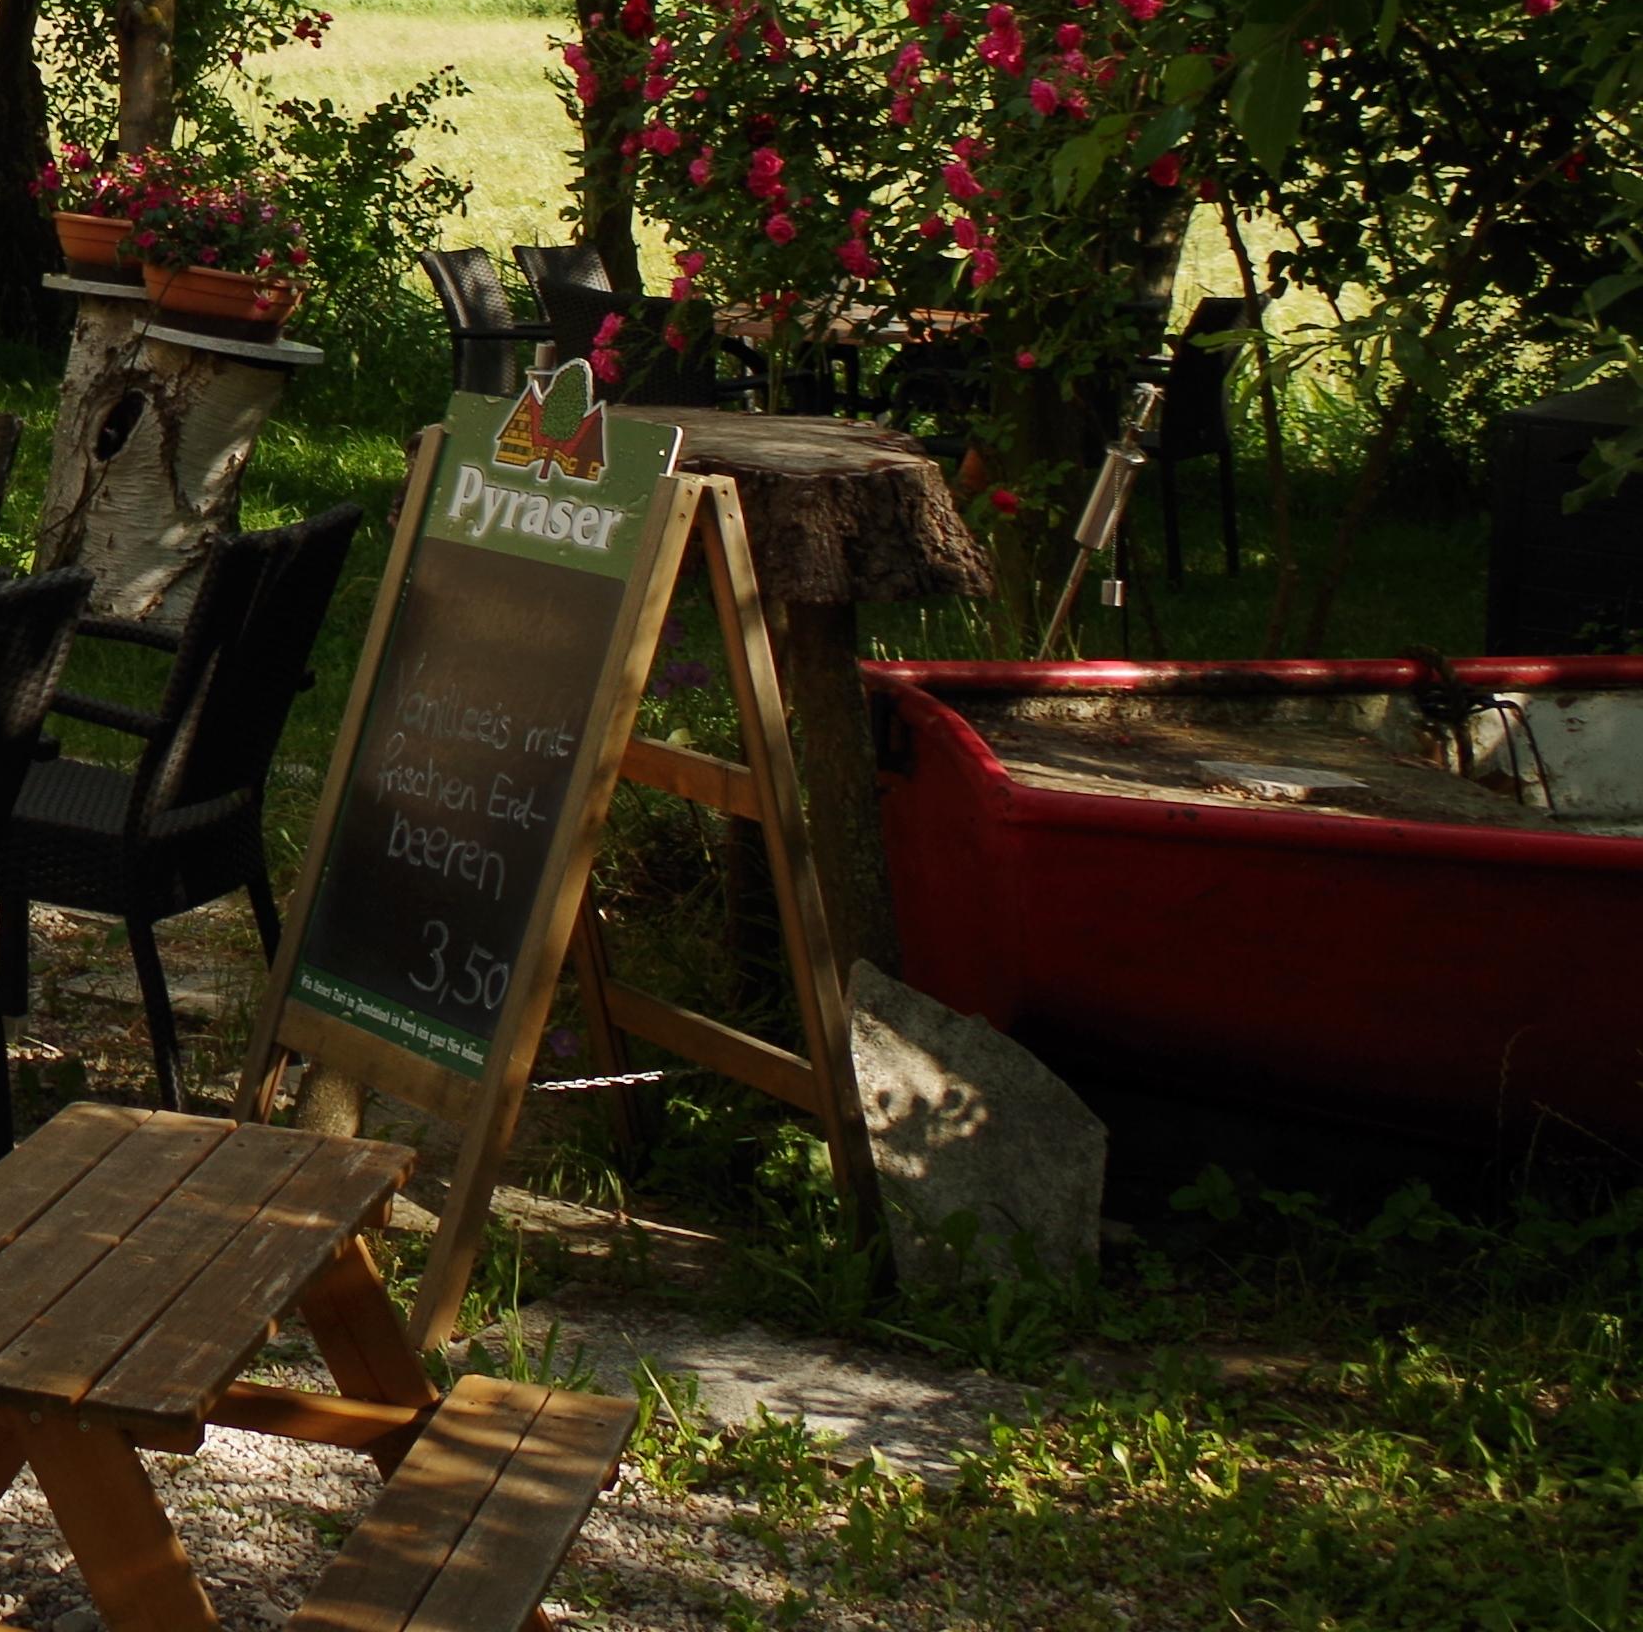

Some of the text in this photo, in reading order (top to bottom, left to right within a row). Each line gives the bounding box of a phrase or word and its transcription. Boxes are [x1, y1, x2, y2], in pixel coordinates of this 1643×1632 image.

[447, 464, 625, 552] Pyraser
[376, 731, 547, 830] frischen Erd-
[525, 720, 576, 758] mit
[387, 810, 506, 902] beeren
[407, 918, 510, 1011] 3,50
